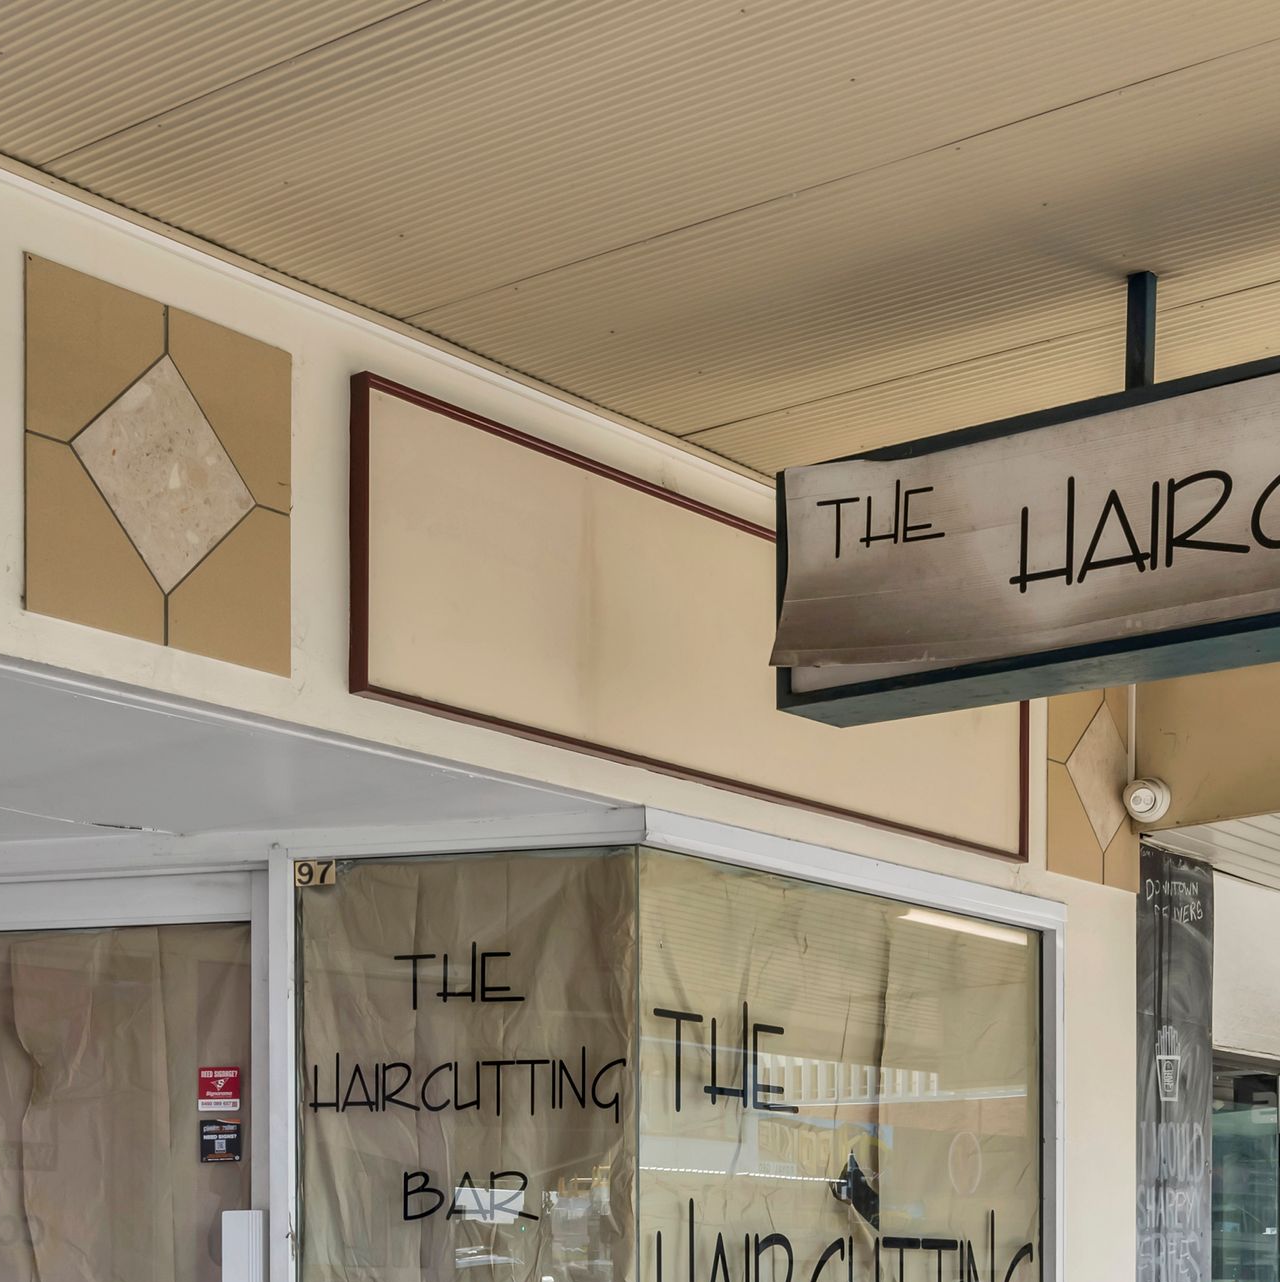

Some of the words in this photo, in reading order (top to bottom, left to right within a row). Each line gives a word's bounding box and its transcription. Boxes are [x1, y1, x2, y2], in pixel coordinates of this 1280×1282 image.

[817, 479, 945, 558] THE
[297, 861, 333, 885] 97
[394, 941, 525, 1010] THE
[309, 1046, 627, 1123] HAIRCUTTING
[654, 1001, 799, 1113] THE
[403, 1170, 539, 1222] BAR
